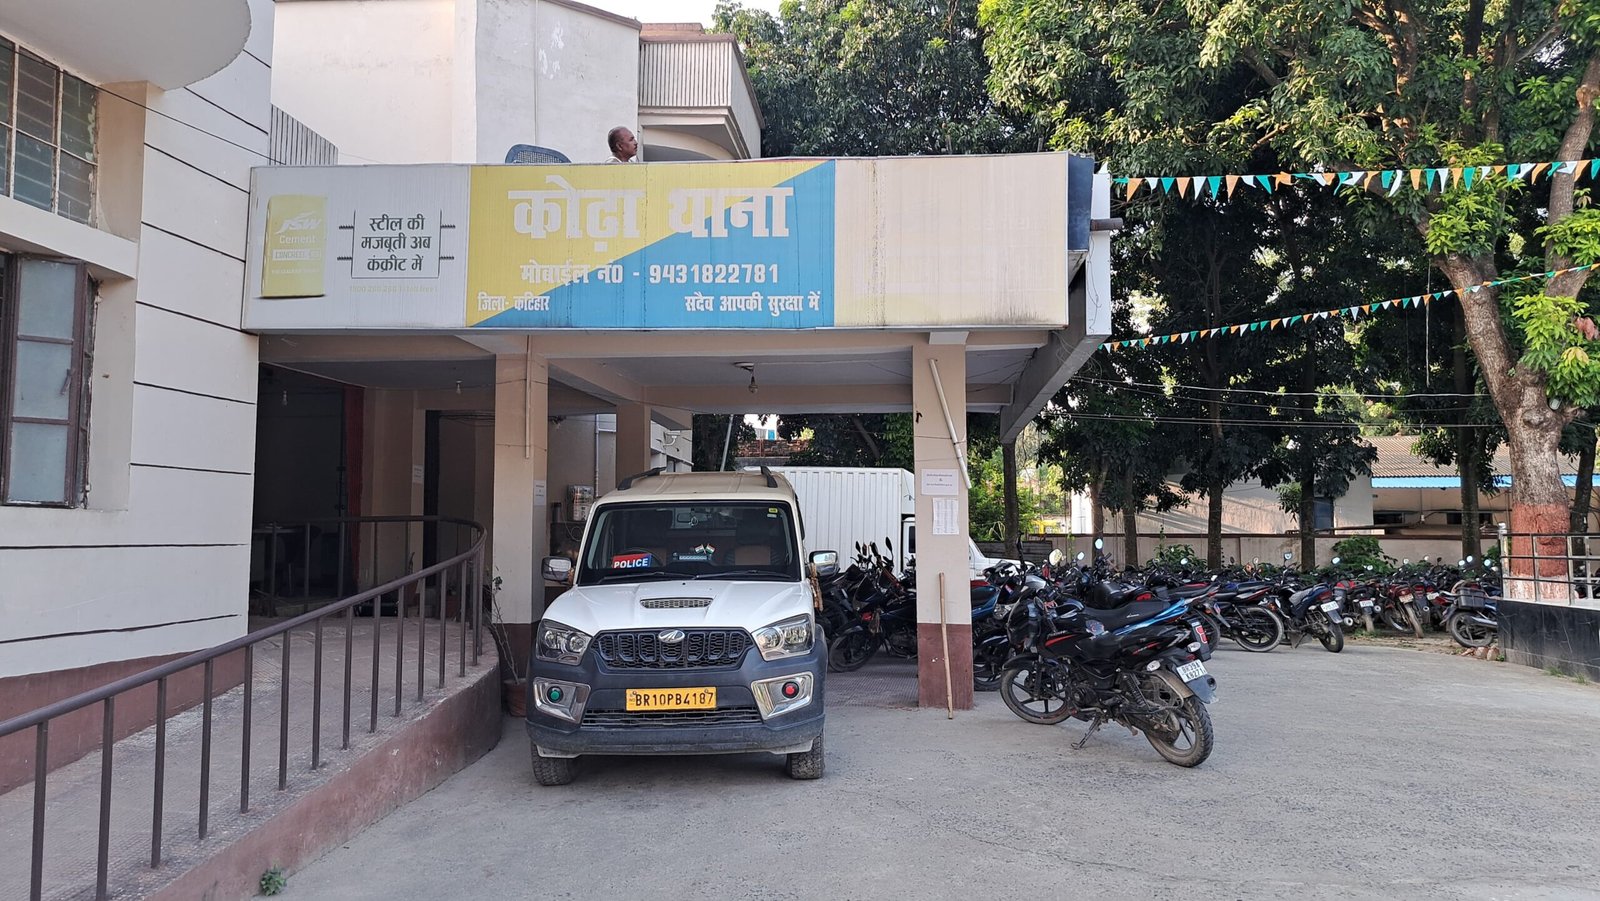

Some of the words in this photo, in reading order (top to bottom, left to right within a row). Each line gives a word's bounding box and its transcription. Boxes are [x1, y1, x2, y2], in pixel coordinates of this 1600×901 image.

[274, 213, 321, 234] JSW
[369, 213, 404, 231] स्टील
[407, 213, 425, 230] की
[508, 175, 646, 252] कोढ़ा
[668, 187, 793, 237] थाना
[279, 235, 317, 244] Cement
[361, 232, 407, 252] मजबूती
[410, 236, 432, 249] अब
[367, 254, 407, 272] कंक्रीट
[411, 254, 424, 271] में
[520, 258, 590, 286] मोबाईल
[649, 264, 779, 283] 9431822781
[513, 291, 550, 311] कटिहार
[684, 291, 714, 312] सदैव
[720, 291, 763, 312] आपकी
[768, 296, 804, 316] सुरक्षा
[808, 290, 821, 311] में
[613, 558, 649, 568] POLICE
[635, 692, 714, 706] BR10PB4187
